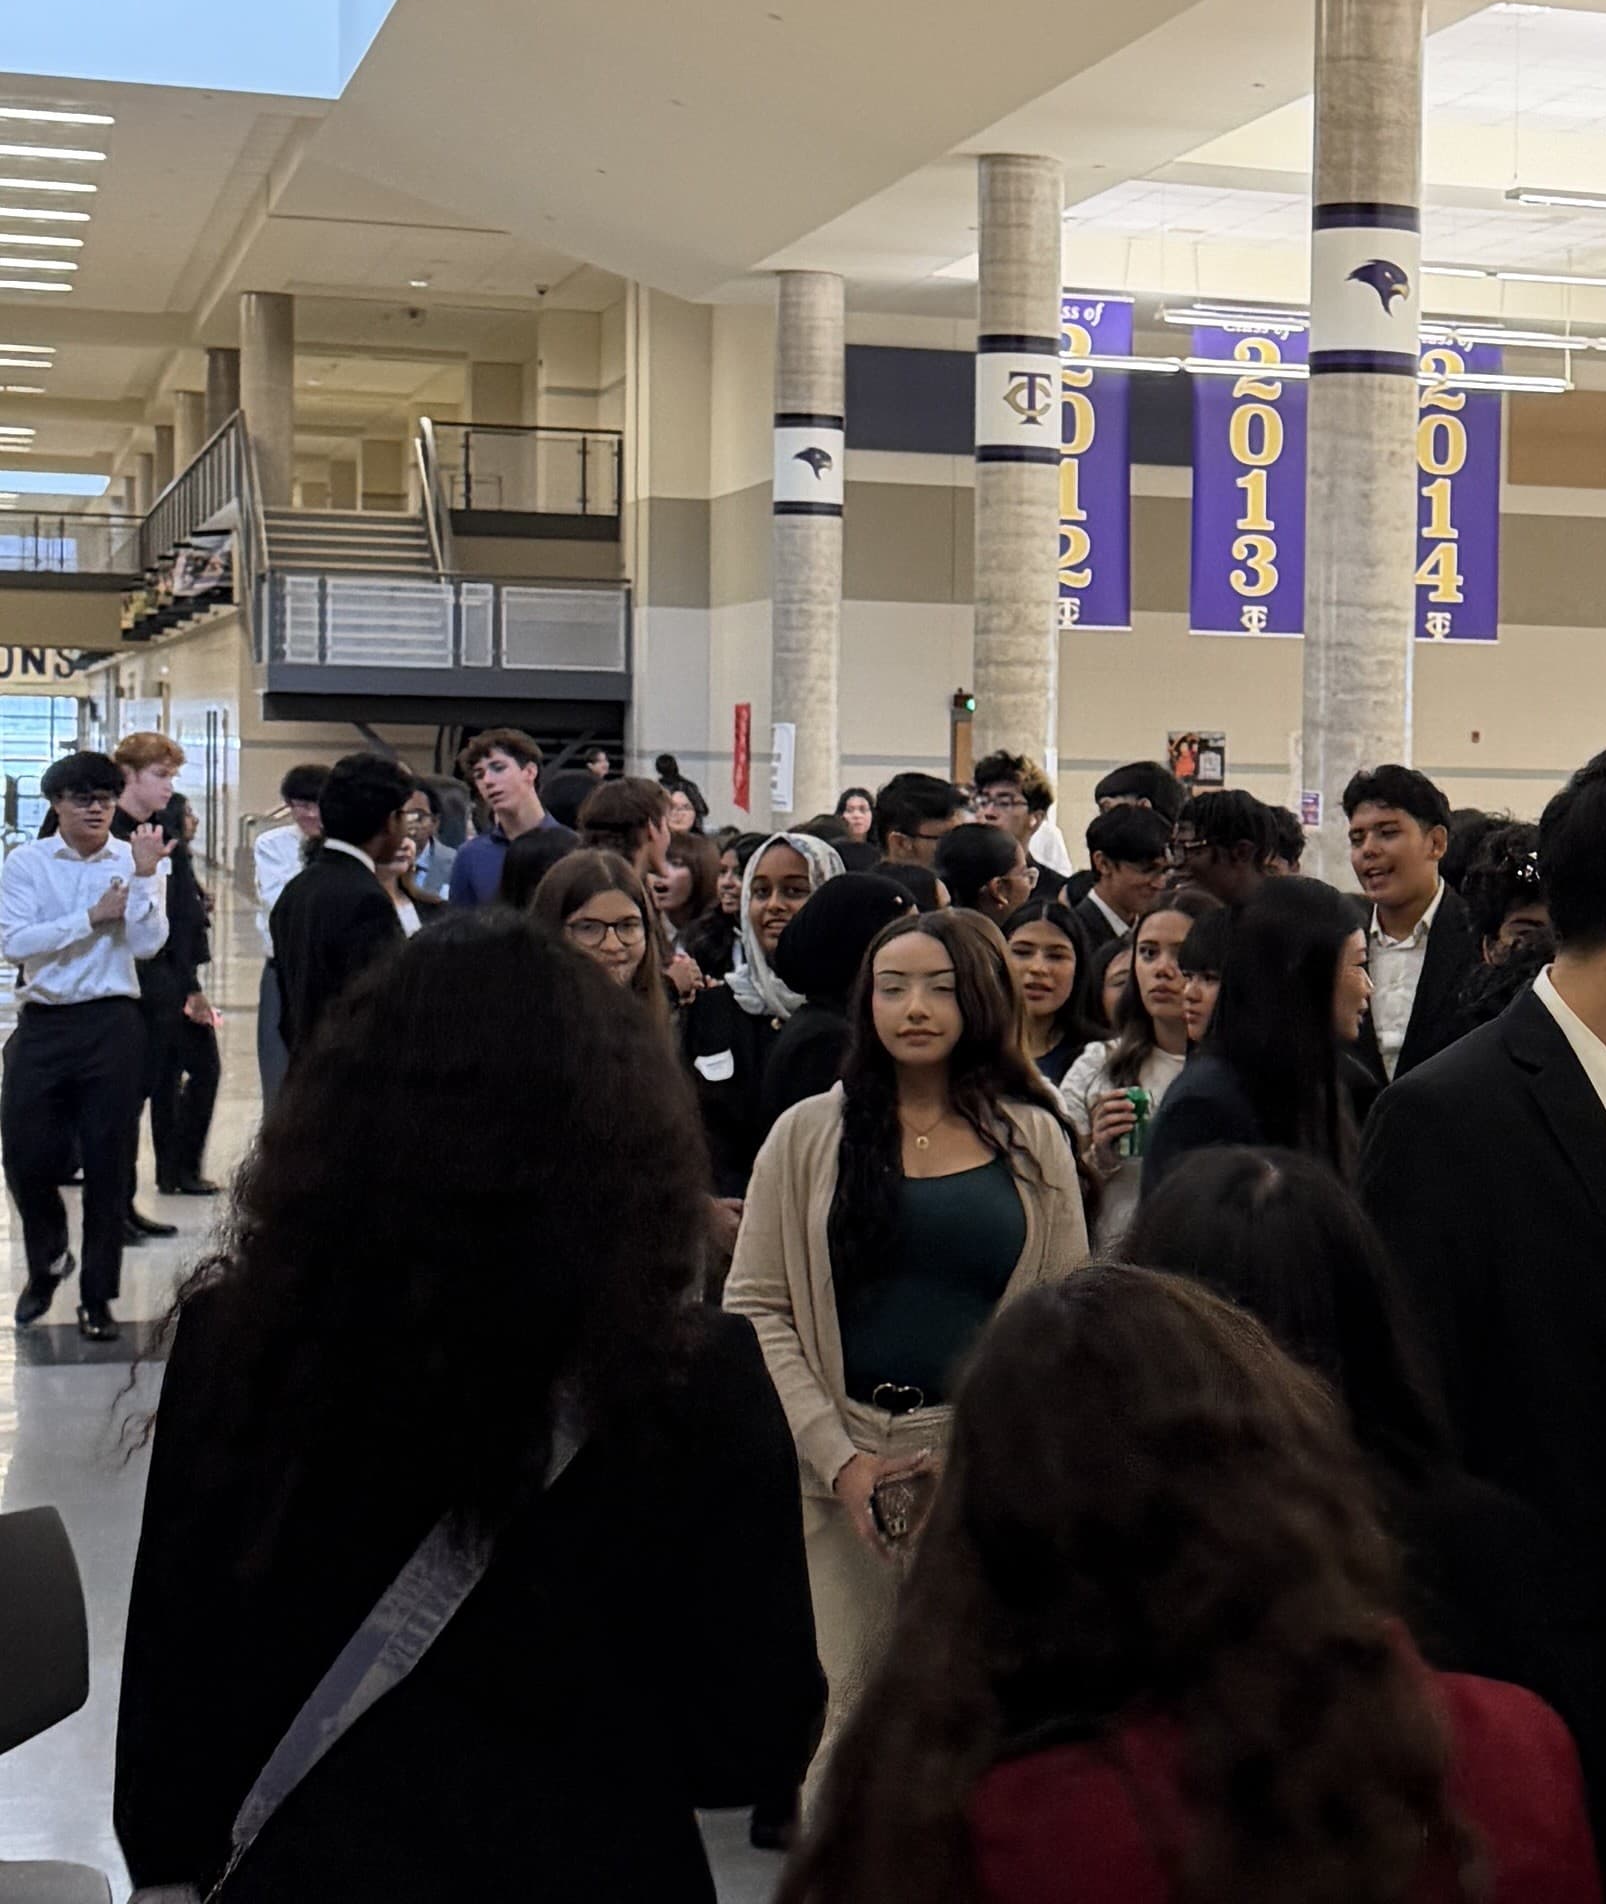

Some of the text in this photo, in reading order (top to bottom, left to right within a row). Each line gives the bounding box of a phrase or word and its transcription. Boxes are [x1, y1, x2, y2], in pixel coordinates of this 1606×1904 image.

[1083, 302, 1105, 327] of
[1229, 336, 1284, 597] 2013
[1414, 348, 1467, 603] 2014
